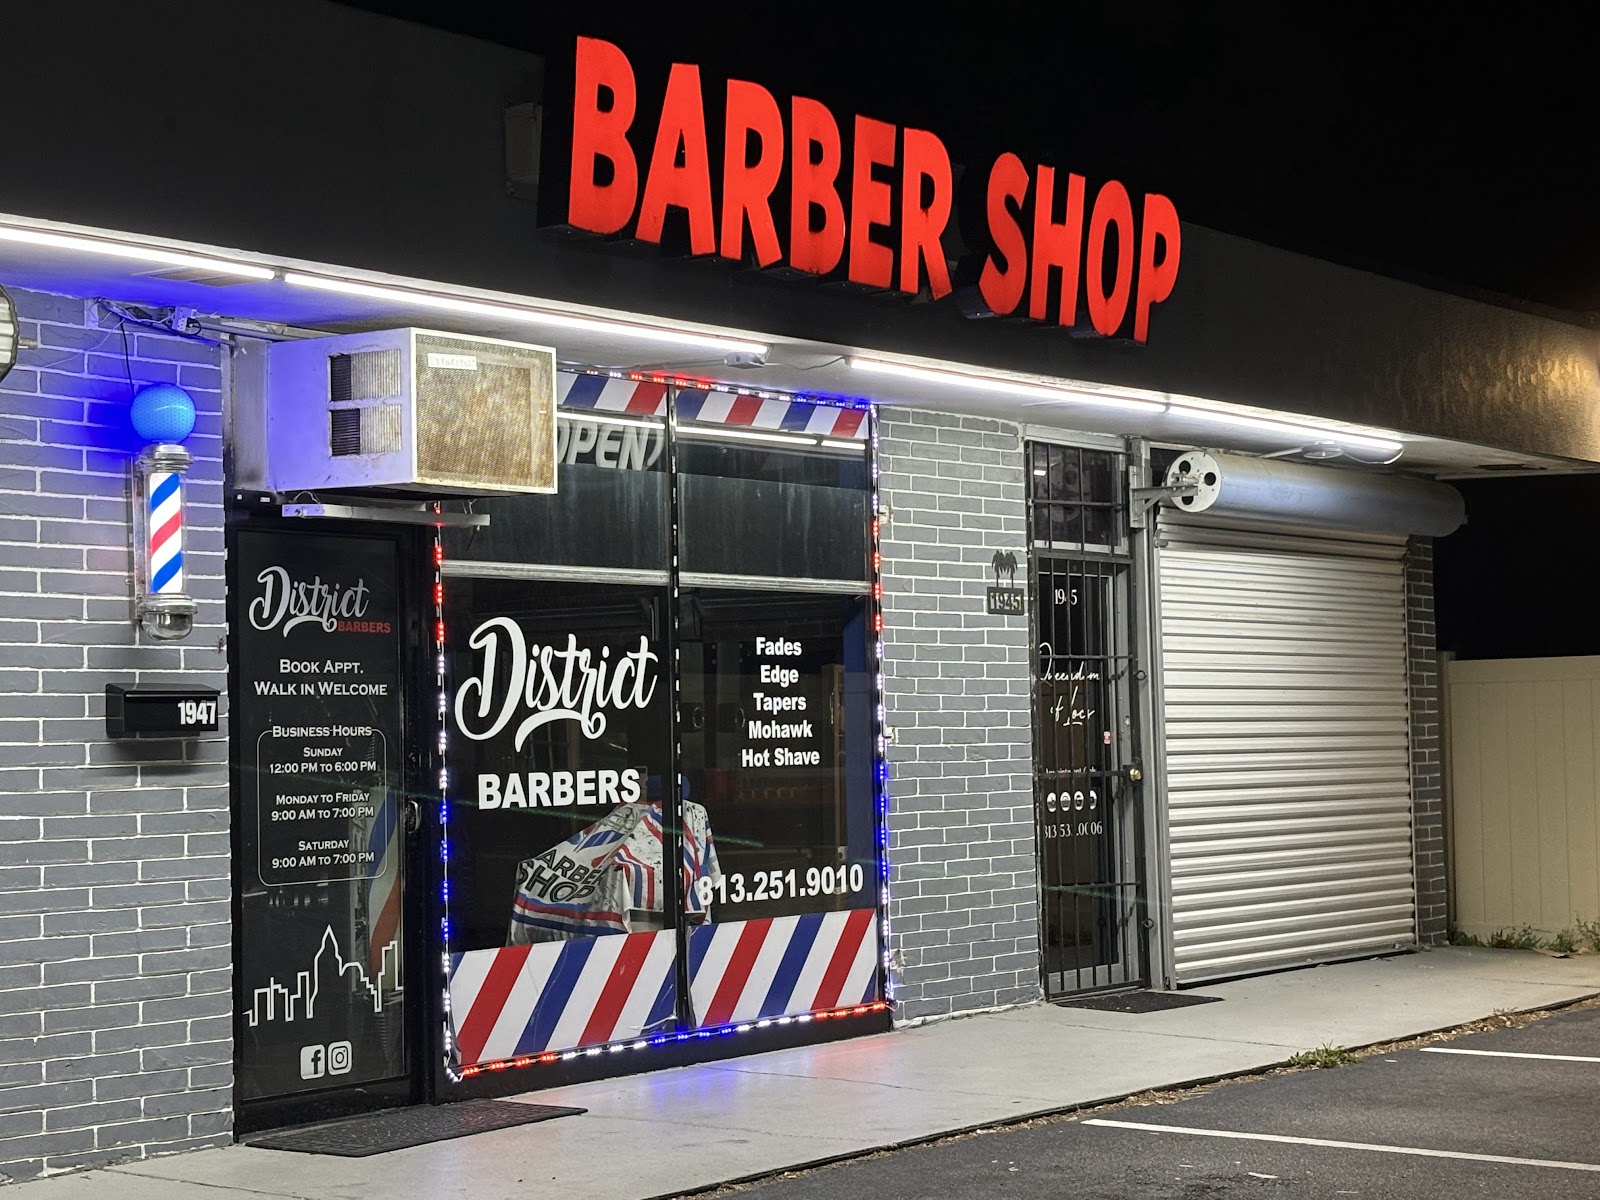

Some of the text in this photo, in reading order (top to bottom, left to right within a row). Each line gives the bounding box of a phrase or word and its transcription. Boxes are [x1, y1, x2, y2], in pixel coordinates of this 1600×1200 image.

[568, 35, 1181, 344] BARBER SHOP
[249, 566, 370, 637] District
[1055, 588, 1078, 606] 195
[337, 621, 391, 634] BARBERS
[756, 637, 802, 656] Fades
[455, 617, 658, 752] District
[760, 665, 799, 688] Edge
[178, 702, 216, 725] 1947
[753, 692, 807, 715] Tapers
[748, 720, 813, 739] Mohawk
[269, 763, 299, 774] 12:00
[301, 762, 318, 773] PM
[334, 761, 358, 772] 6:00
[360, 761, 377, 771] PM
[742, 747, 820, 767] Hot Shave
[478, 769, 641, 810] BARBERS
[271, 810, 296, 821] 9:00
[298, 809, 315, 820] AM
[332, 808, 356, 818] 7:00
[358, 807, 374, 817] PM
[272, 858, 297, 869] 9:00
[298, 856, 316, 867] AM
[333, 854, 357, 864] 7:00
[358, 852, 375, 863] PM
[534, 849, 604, 886] ARBE
[518, 860, 596, 902] SHOP
[698, 863, 864, 906] 813.251.9010
